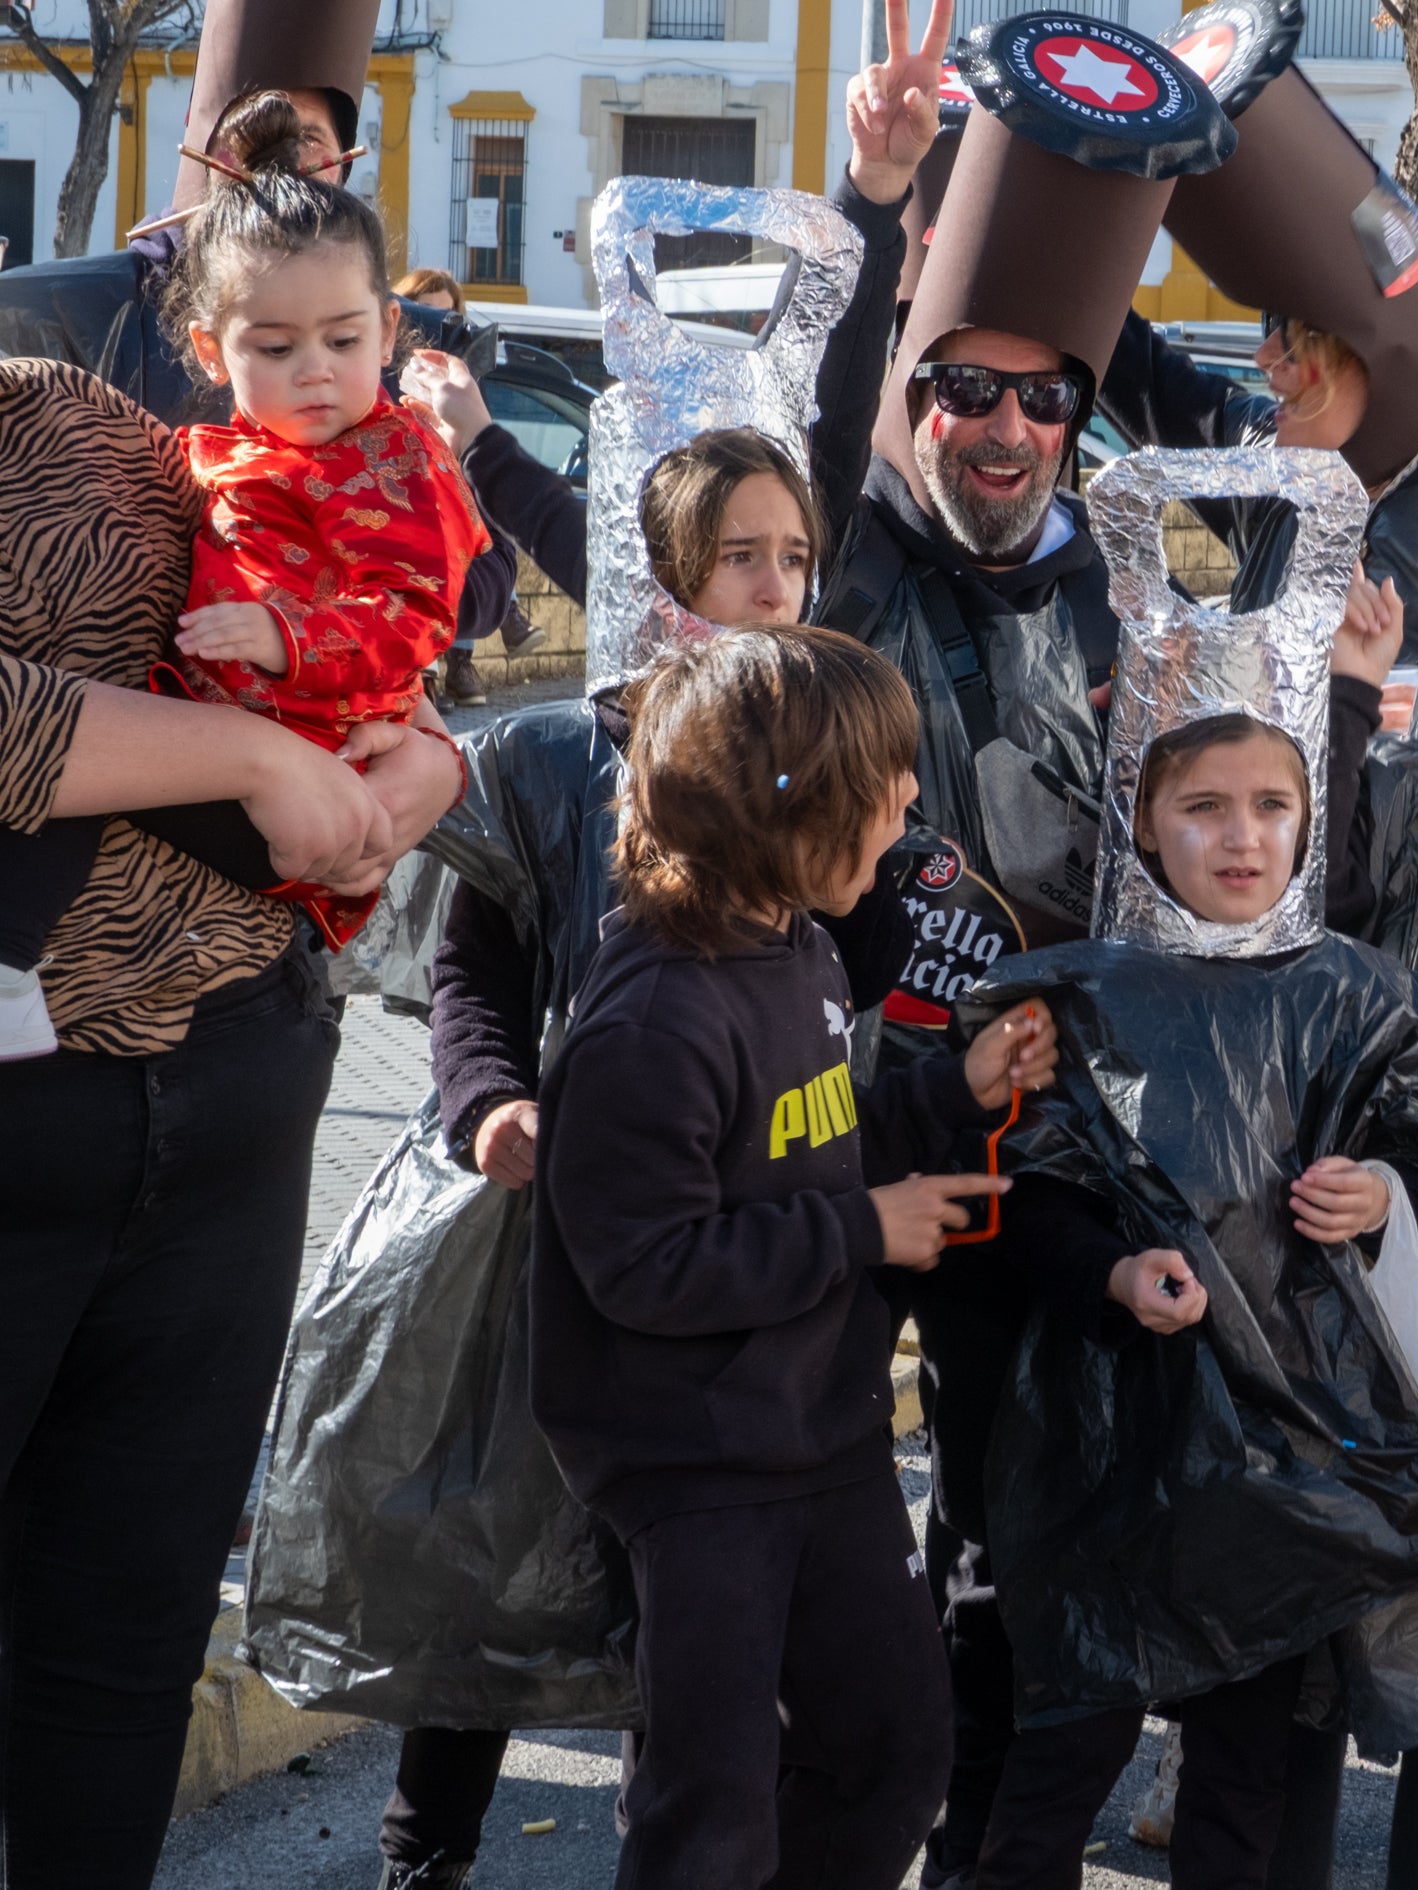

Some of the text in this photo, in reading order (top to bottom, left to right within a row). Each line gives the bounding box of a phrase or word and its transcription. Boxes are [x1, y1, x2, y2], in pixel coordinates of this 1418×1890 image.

[1012, 35, 1129, 125] ESTRELLA GALICIA
[1043, 21, 1183, 119] CERVECEROS DESDE 1906
[1038, 881, 1092, 922] adidas
[769, 1061, 859, 1160] PUM
